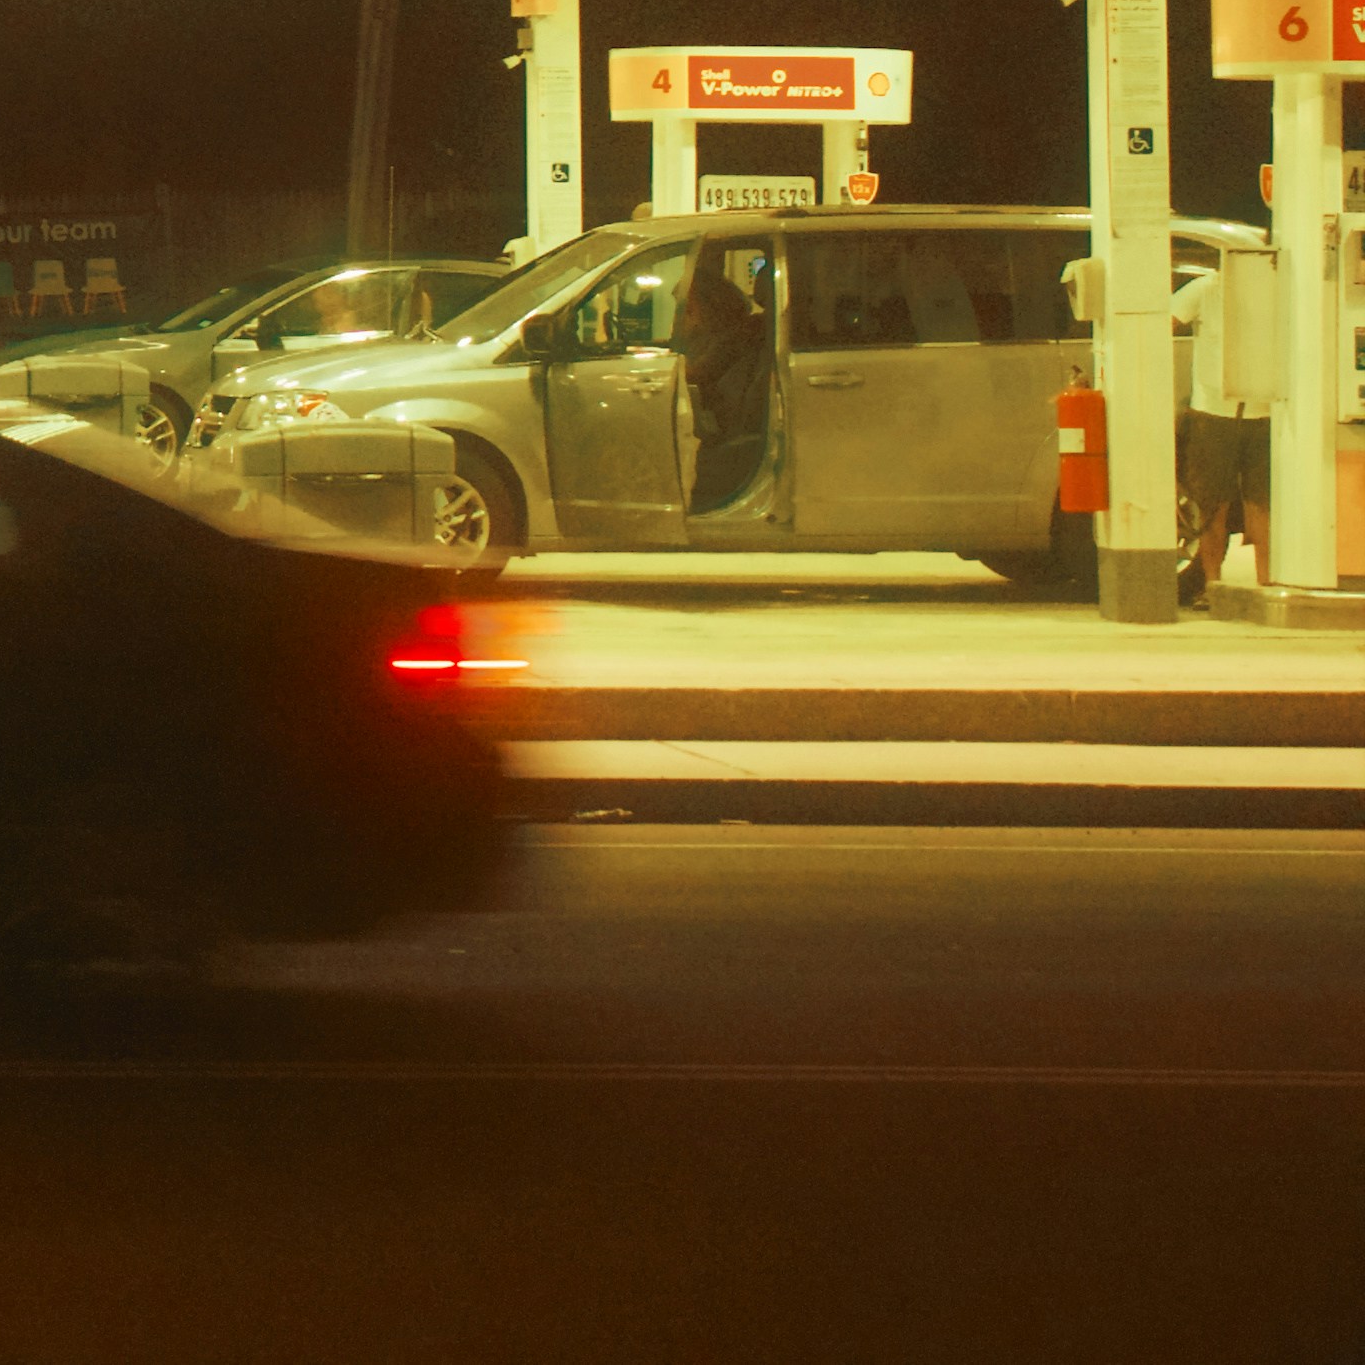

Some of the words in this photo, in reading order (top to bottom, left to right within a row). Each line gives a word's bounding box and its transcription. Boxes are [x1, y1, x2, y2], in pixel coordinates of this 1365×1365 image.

[1352, 6, 1365, 21] S
[1278, 6, 1310, 42] 6
[652, 68, 672, 94] 4
[701, 68, 730, 81] Shell
[701, 81, 779, 97] V-Power
[705, 188, 733, 208] 489
[742, 188, 770, 207] 539
[39, 218, 117, 242] team
